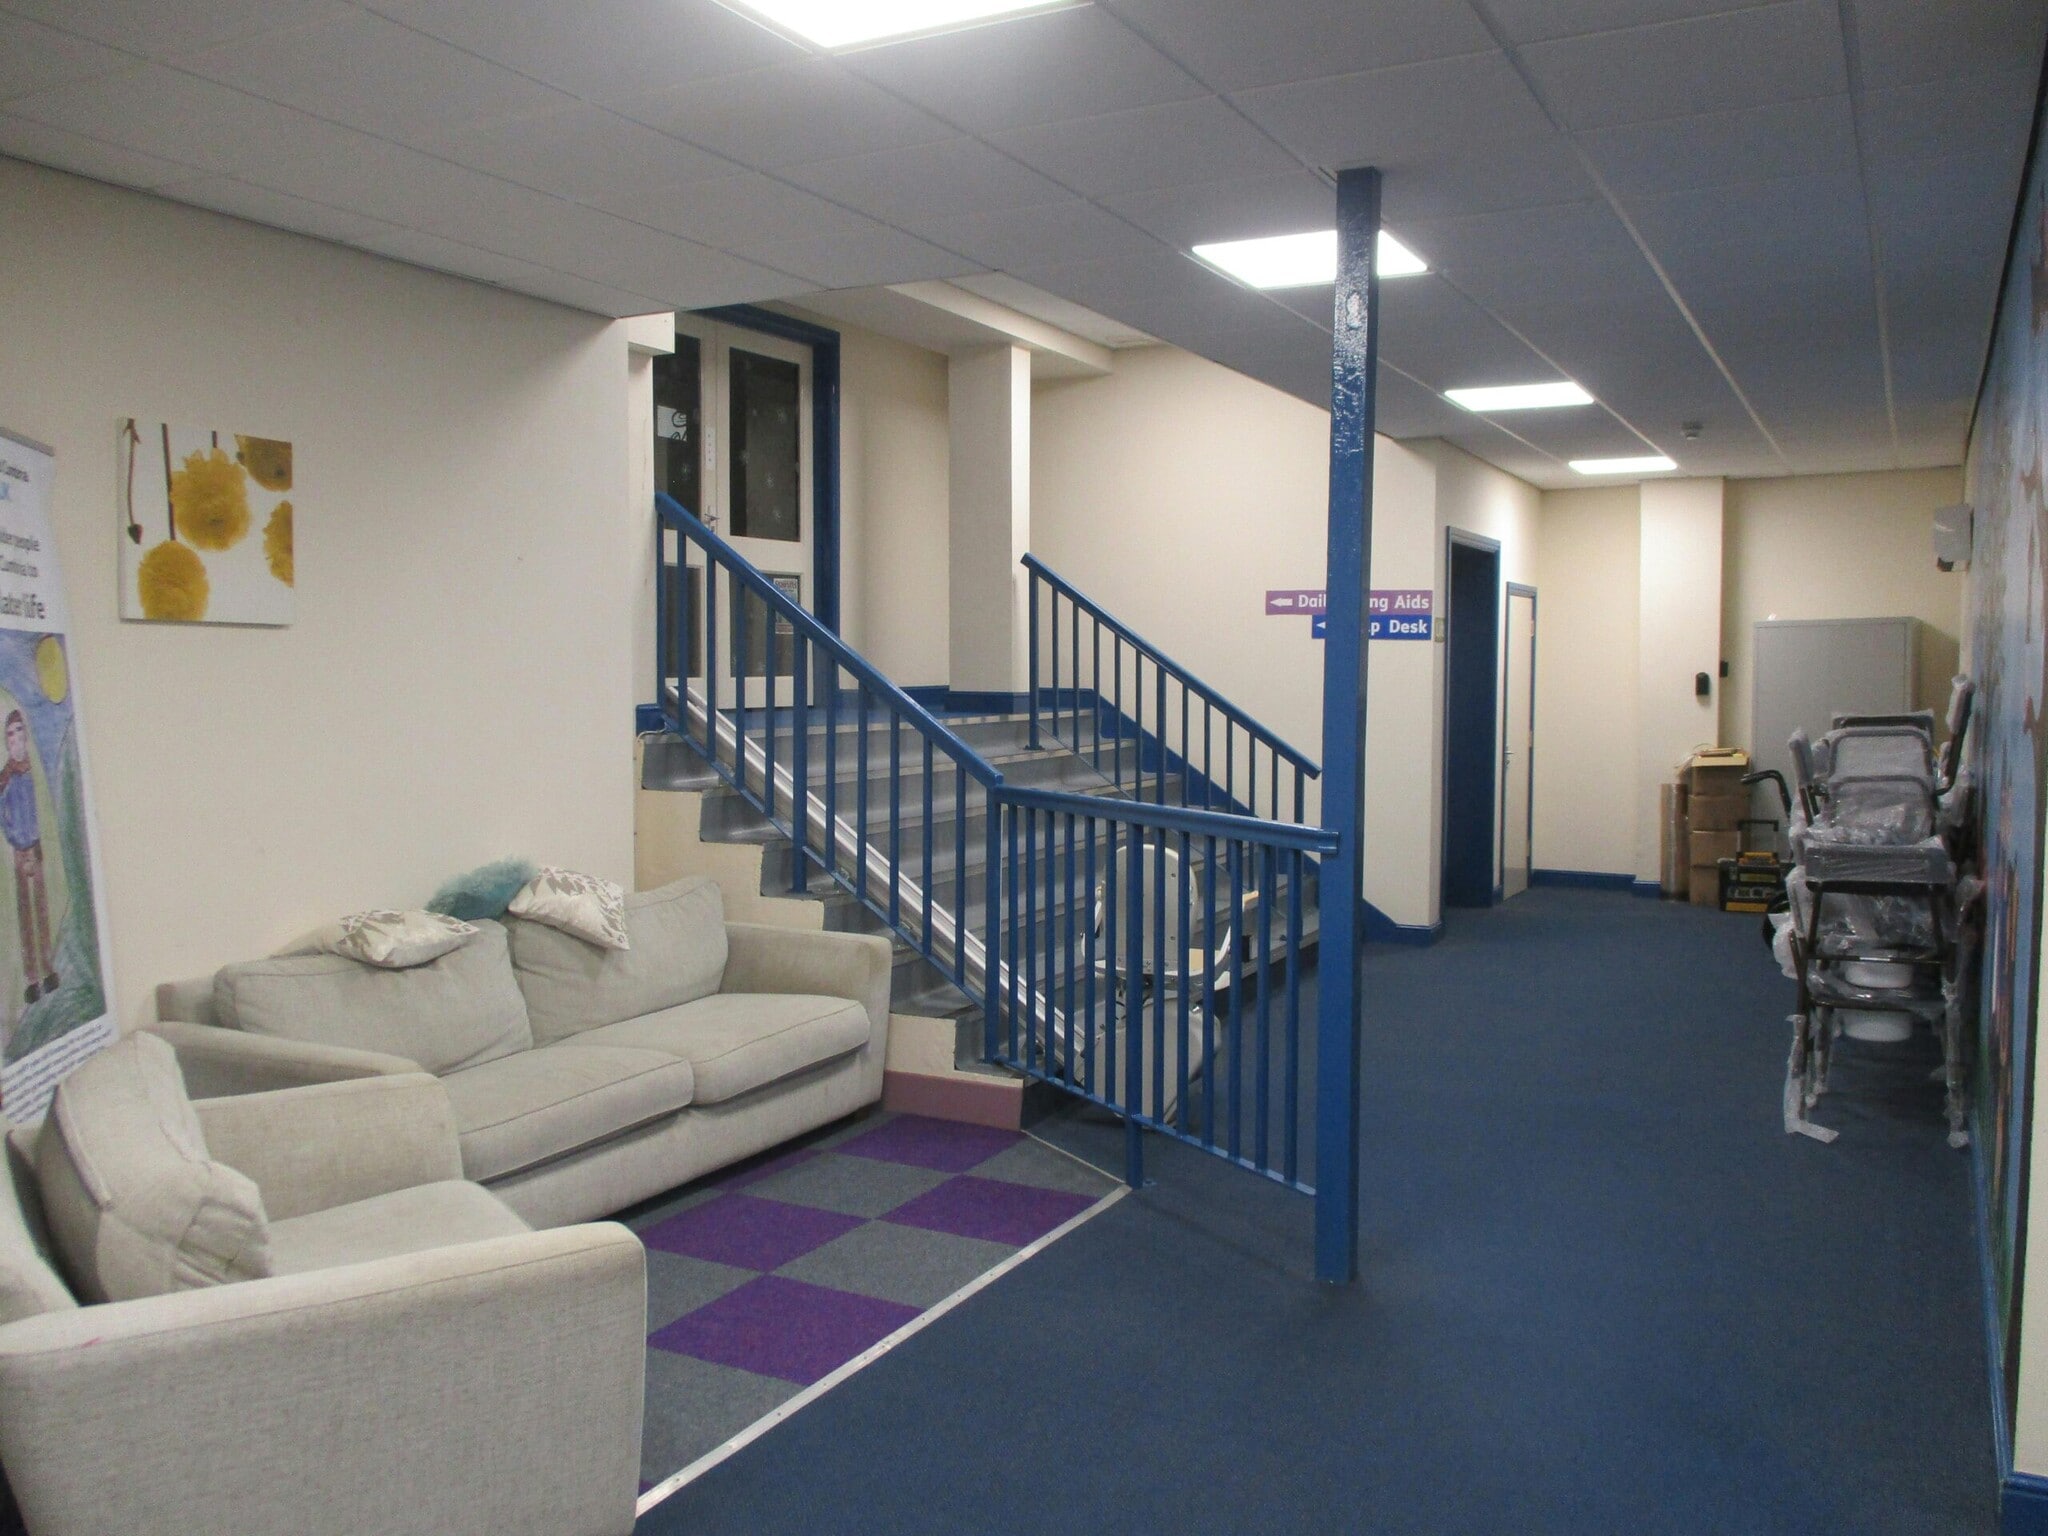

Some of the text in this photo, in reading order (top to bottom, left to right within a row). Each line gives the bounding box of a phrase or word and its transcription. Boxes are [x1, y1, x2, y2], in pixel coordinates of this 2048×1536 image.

[1298, 594, 1326, 608] Dail
[1394, 594, 1430, 609] Aids
[1389, 619, 1428, 634] Desk
